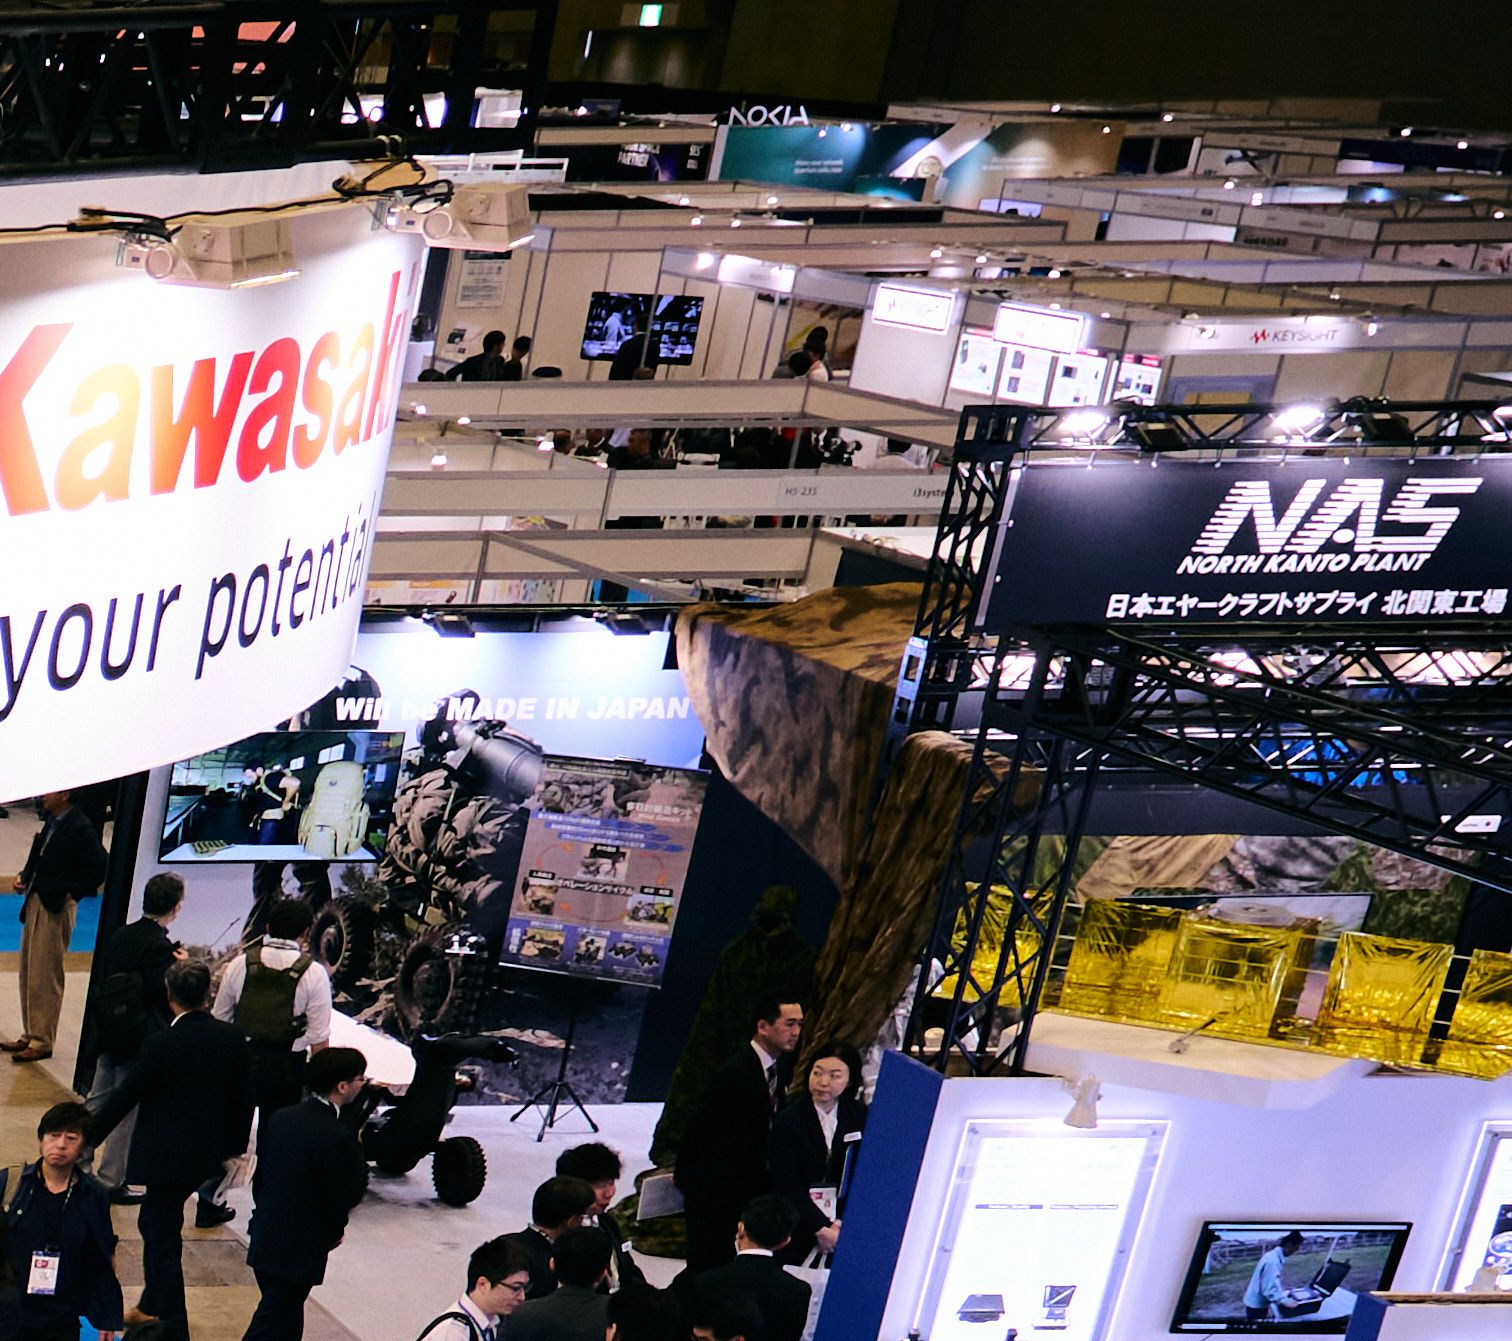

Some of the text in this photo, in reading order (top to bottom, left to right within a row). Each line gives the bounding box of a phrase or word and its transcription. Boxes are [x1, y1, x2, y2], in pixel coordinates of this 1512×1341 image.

[728, 105, 809, 126] NOKIA
[1271, 329, 1339, 342] KEYSIGHT
[912, 487, 948, 499] i3syste
[1190, 477, 1483, 555] NAS
[1176, 551, 1432, 575] NORTH KANTO PLANT
[195, 490, 378, 680] potential
[1104, 588, 1508, 620] 日本エヤークラフトサプライ 北関東工場
[333, 696, 690, 720] Will be MADE IN JAPAN
